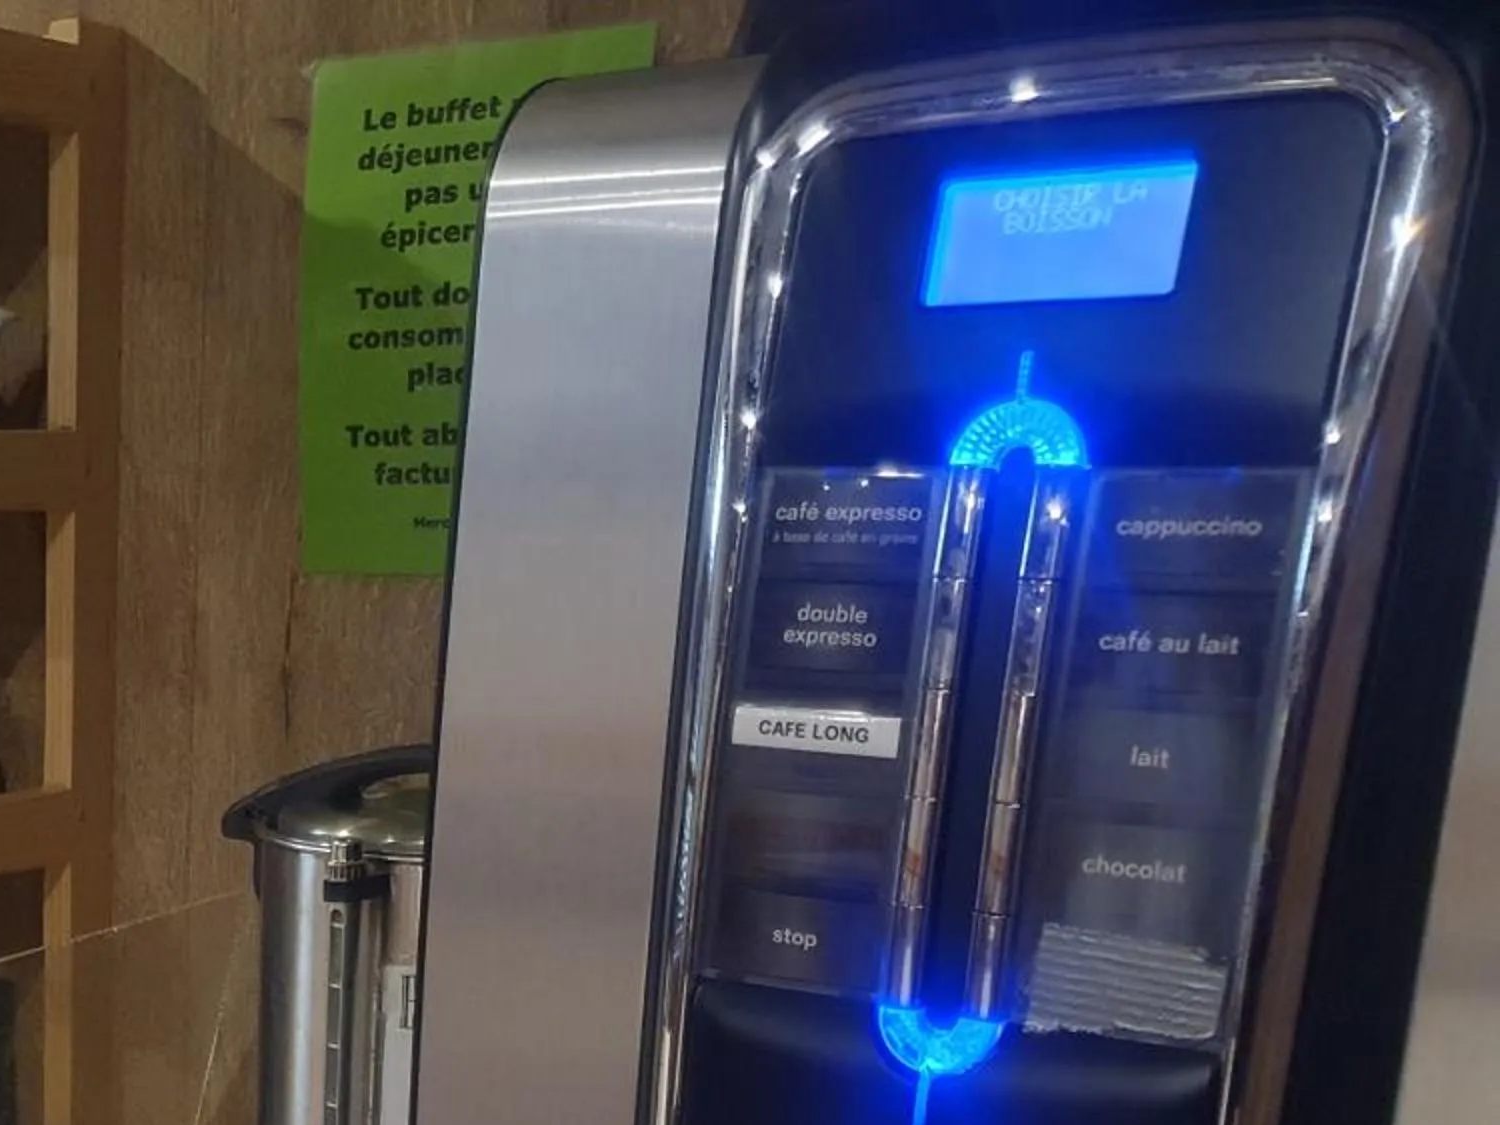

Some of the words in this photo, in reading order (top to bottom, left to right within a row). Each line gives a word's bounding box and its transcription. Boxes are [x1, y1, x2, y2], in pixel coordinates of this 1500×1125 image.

[363, 108, 397, 132] Le
[407, 95, 502, 128] buffet
[404, 183, 459, 214] pas
[1113, 178, 1149, 204] LA
[380, 220, 475, 253] épicer
[355, 285, 423, 311] Tout
[432, 280, 471, 306] do
[347, 325, 464, 351] consom
[345, 423, 413, 448] Tout
[422, 421, 458, 446] ab
[374, 461, 451, 486] factu
[413, 516, 450, 530] Merc
[775, 501, 820, 521] café
[825, 506, 923, 525] expresso
[1115, 517, 1264, 540] cappuccino
[797, 602, 868, 624] double
[783, 628, 878, 649] expresso
[1099, 630, 1151, 652] café
[1158, 636, 1190, 654] au
[1197, 633, 1241, 655] lait
[758, 719, 806, 739] CAFE
[812, 723, 870, 744] LONG
[1130, 745, 1171, 769] lait
[1082, 854, 1188, 884] chocolat
[772, 927, 818, 951] stop
